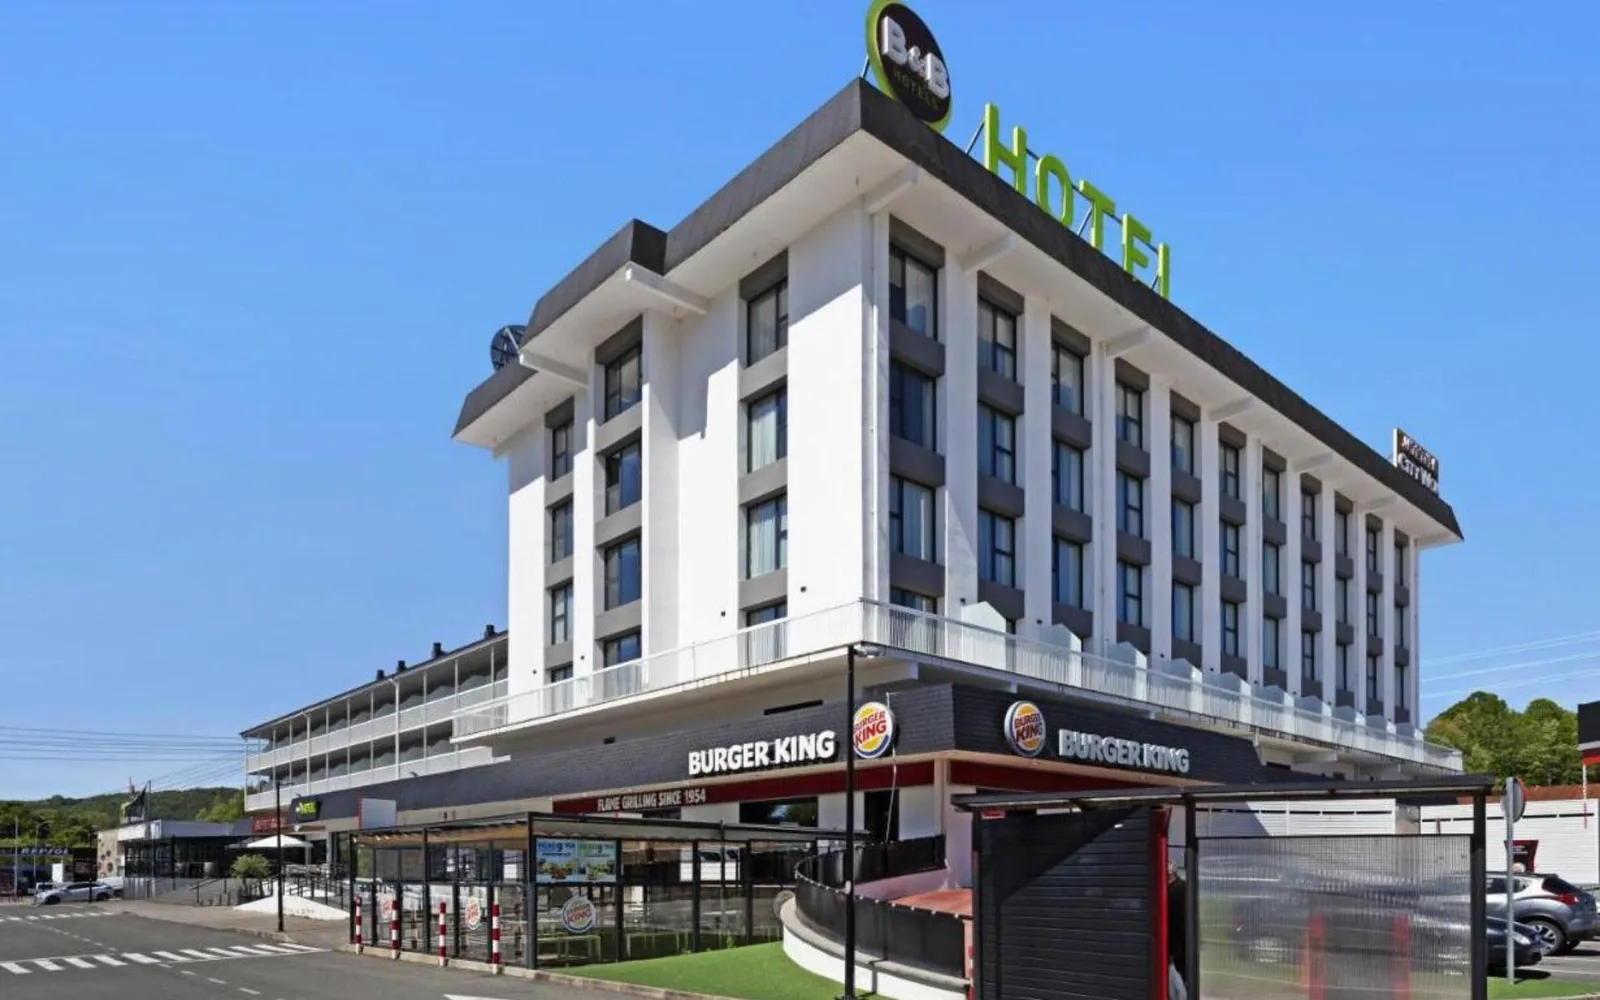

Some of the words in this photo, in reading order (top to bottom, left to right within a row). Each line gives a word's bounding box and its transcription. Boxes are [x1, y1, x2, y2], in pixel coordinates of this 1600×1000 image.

[883, 15, 950, 99] B&B
[688, 740, 770, 776] BURGER
[774, 729, 837, 764] KING
[854, 720, 887, 749] KING
[1058, 728, 1142, 767] BURGER
[1142, 742, 1190, 774] KING
[597, 797, 621, 813] FLAME
[622, 792, 657, 810] GRILLING
[658, 789, 682, 807] SINCE
[684, 787, 706, 804] 1954
